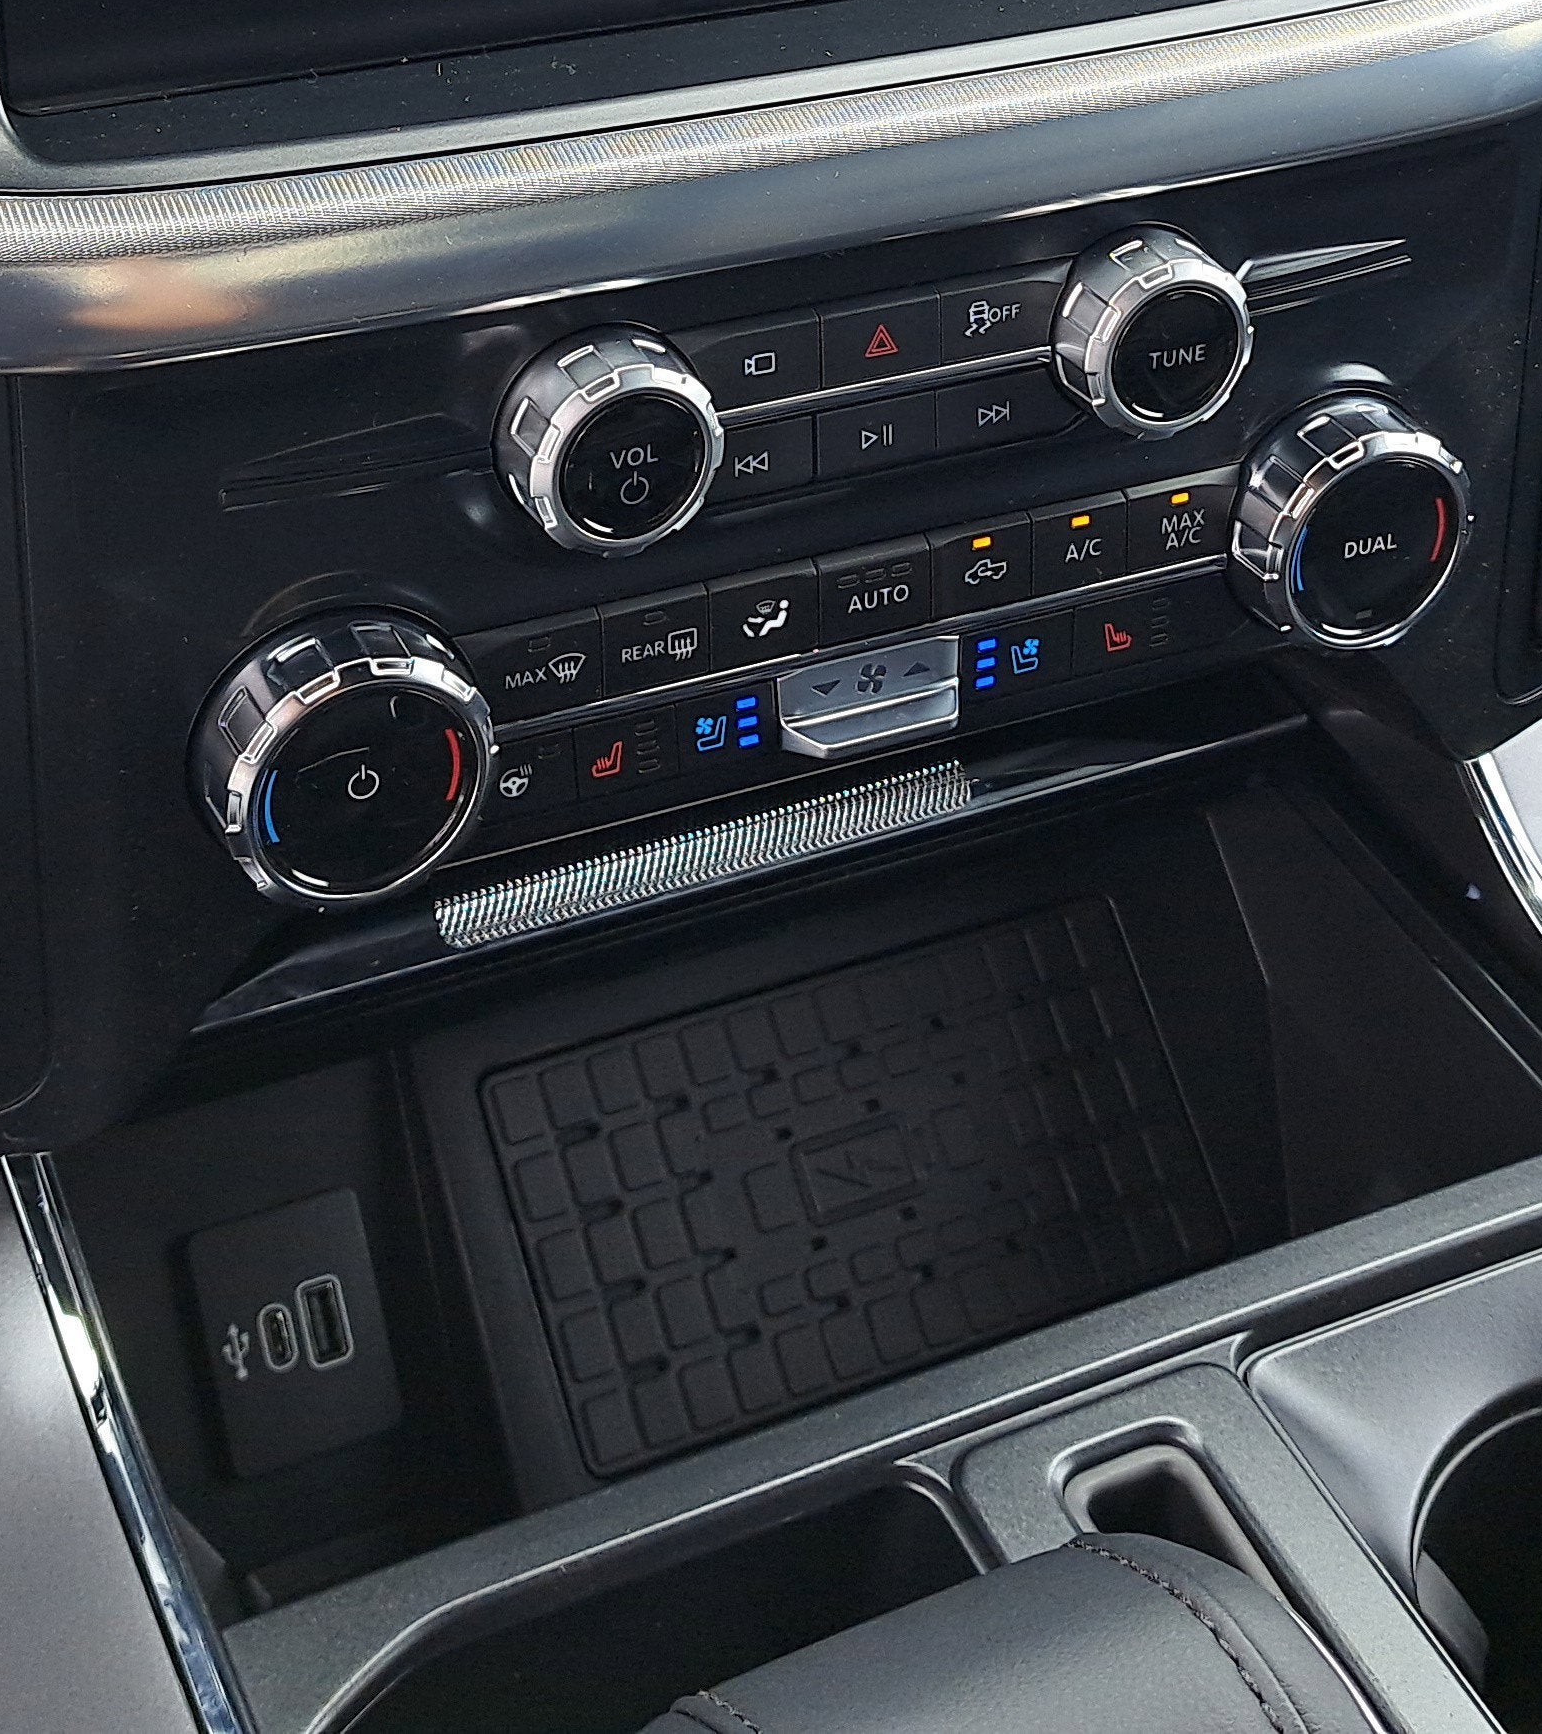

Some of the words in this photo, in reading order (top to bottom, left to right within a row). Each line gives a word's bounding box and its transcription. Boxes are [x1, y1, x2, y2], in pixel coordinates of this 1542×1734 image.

[988, 300, 1021, 324] OFF
[1148, 344, 1207, 369] TUNE
[610, 445, 659, 470] VOL
[1161, 508, 1205, 534] MAX
[1064, 537, 1103, 562] A/C
[1165, 526, 1202, 551] A/C
[1343, 533, 1397, 559] DUAL
[847, 584, 910, 615] AUTO
[620, 640, 665, 664] REAR
[504, 666, 548, 690] MAX
